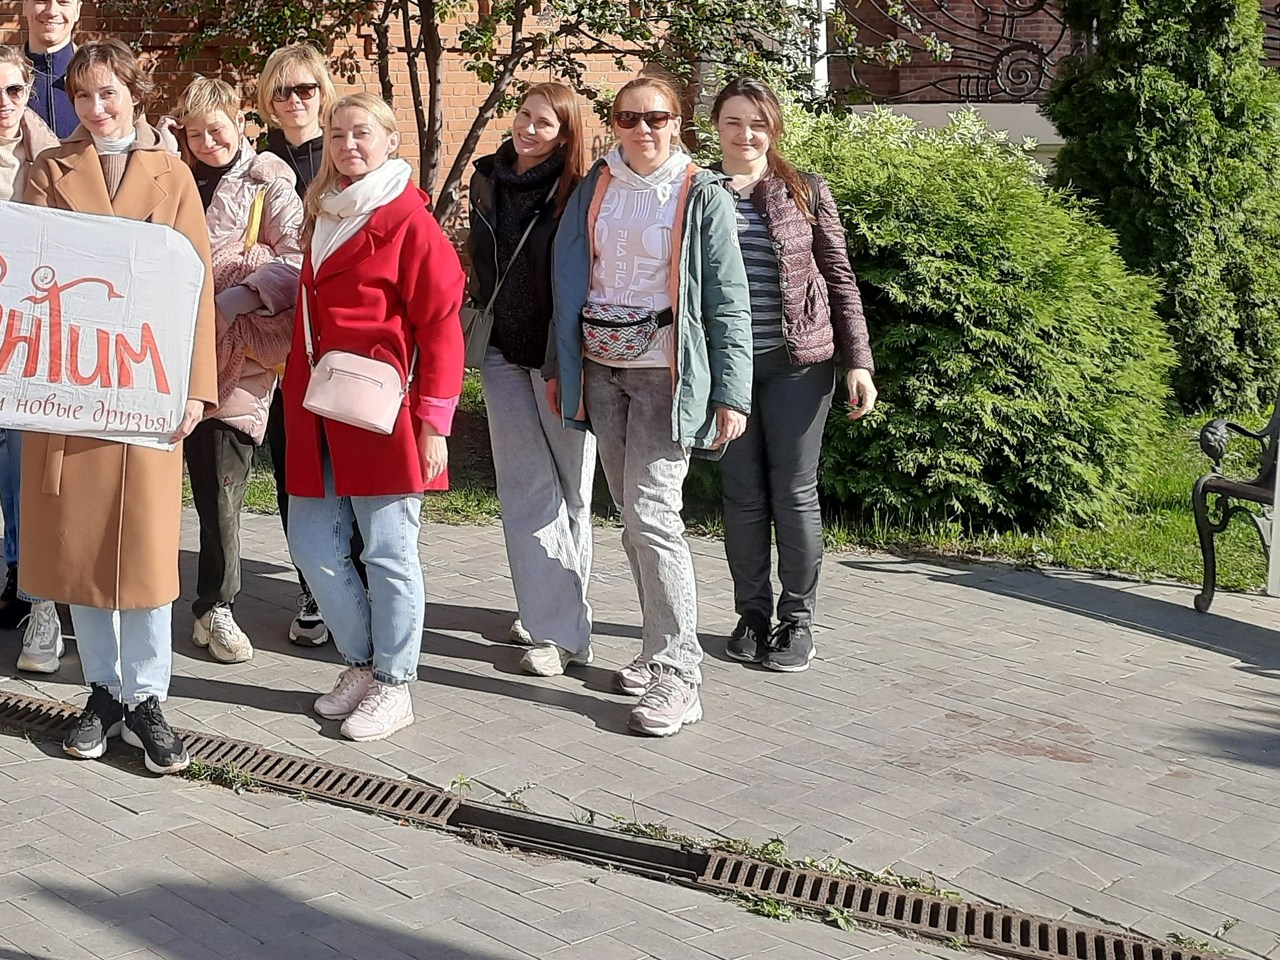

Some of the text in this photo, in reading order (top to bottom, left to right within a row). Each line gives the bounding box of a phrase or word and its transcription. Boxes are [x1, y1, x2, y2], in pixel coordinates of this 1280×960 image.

[615, 229, 628, 289] FILA FILA
[15, 392, 84, 421] новые
[91, 400, 174, 433] друзья!
